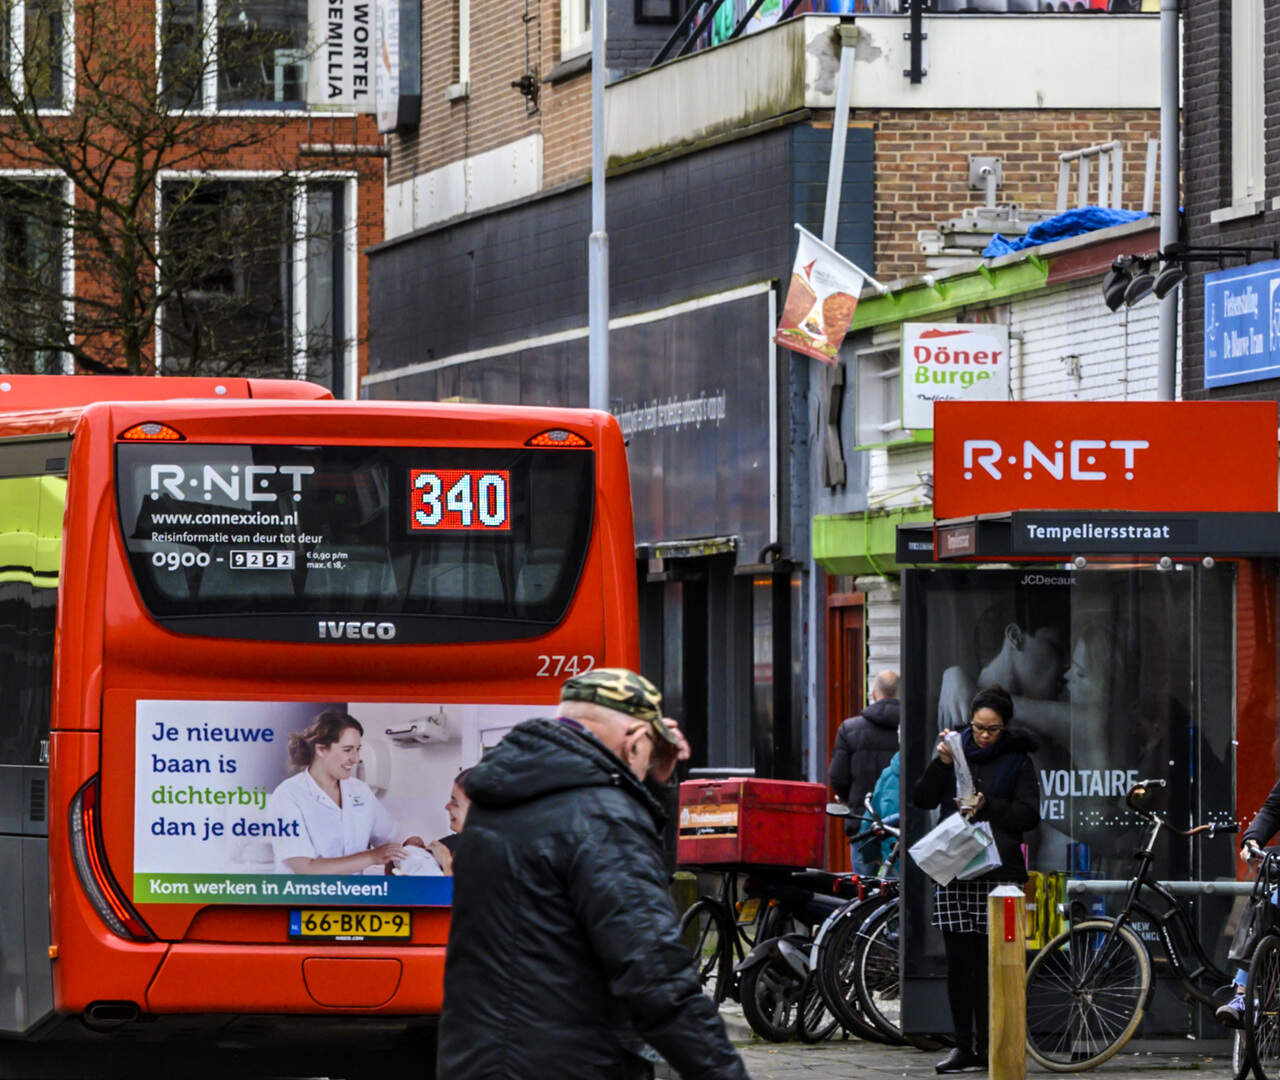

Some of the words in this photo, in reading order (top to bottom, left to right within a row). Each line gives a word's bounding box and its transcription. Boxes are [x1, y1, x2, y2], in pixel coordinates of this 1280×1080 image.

[353, 4, 369, 100] WORTEL
[914, 346, 1003, 365] Döner
[915, 366, 996, 389] Burge
[414, 473, 507, 526] 340
[151, 512, 298, 525] www.connexxion.nl
[151, 532, 229, 544] Reisinformatie
[231, 535, 250, 543] van
[252, 533, 277, 544] deur
[279, 533, 296, 543] tot
[298, 534, 323, 544] deur
[1027, 524, 1170, 542] Tempeliersstraat
[152, 552, 210, 571] 0900
[233, 552, 293, 568] 9292
[1021, 574, 1077, 586] JCDecaux
[318, 621, 396, 639] IVECO
[536, 655, 595, 677] 2742
[152, 722, 179, 742] Je
[187, 724, 274, 743] nieuwe
[152, 754, 211, 773] baan
[219, 754, 237, 773] is
[151, 785, 267, 810] dichterbij
[151, 818, 196, 837] dan
[202, 818, 224, 840] je
[232, 819, 300, 837] denkt
[149, 879, 189, 895] Kom
[193, 880, 257, 895] werken
[262, 881, 279, 895] in
[283, 881, 388, 896] Amstelveen!
[305, 913, 405, 933] 66-BKD-9
